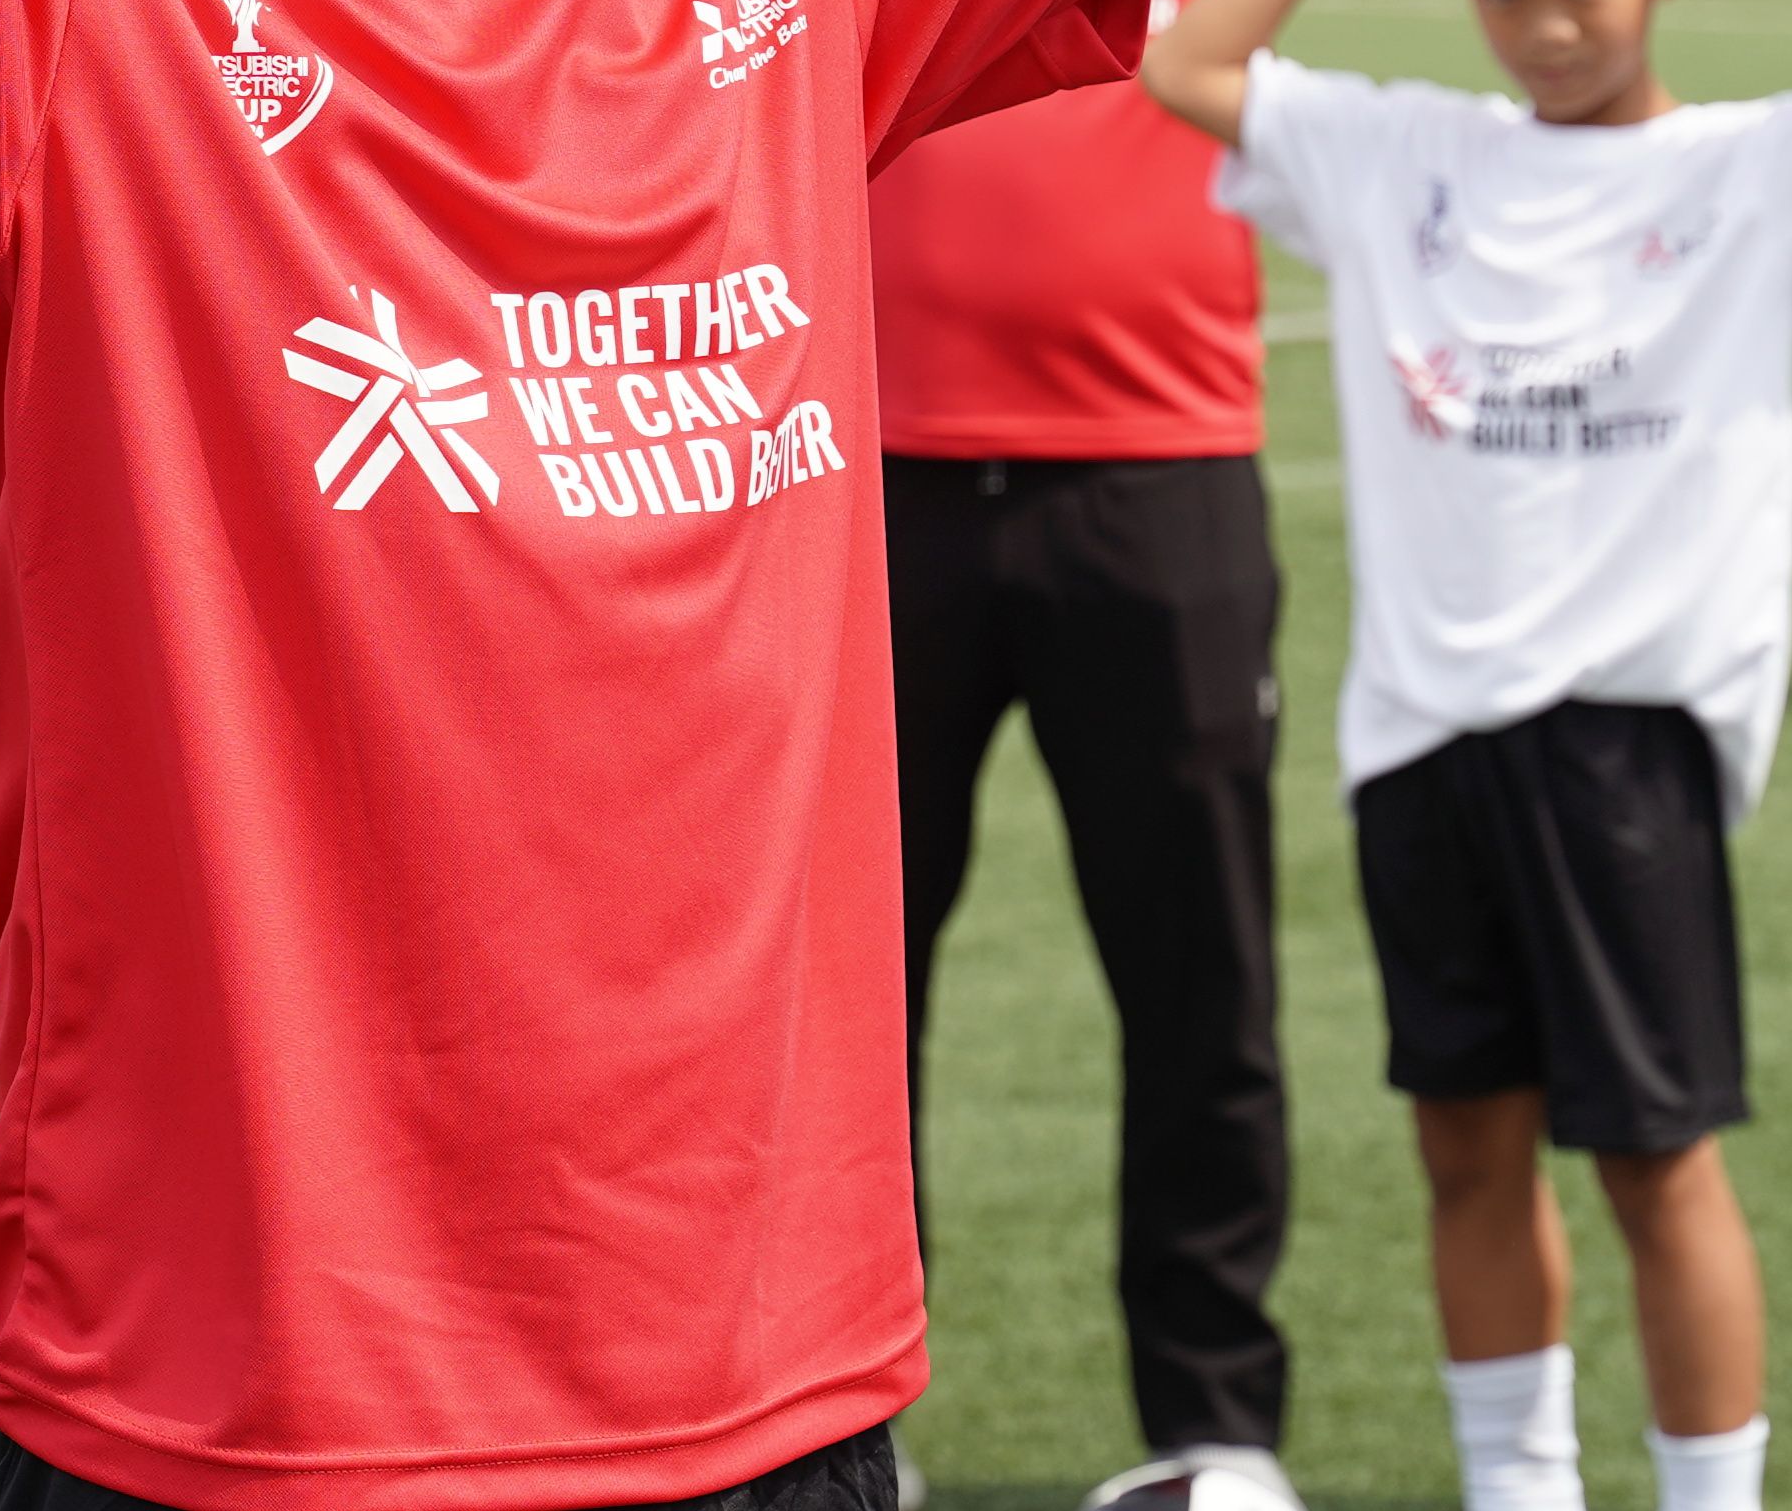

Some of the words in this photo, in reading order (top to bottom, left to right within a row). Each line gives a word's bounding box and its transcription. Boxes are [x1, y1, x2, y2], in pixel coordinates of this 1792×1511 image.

[491, 263, 811, 369] TOGETHER
[509, 376, 614, 446] WE
[616, 364, 763, 438] CAN
[539, 438, 735, 518] BUILD
[747, 400, 846, 508] BETTER
